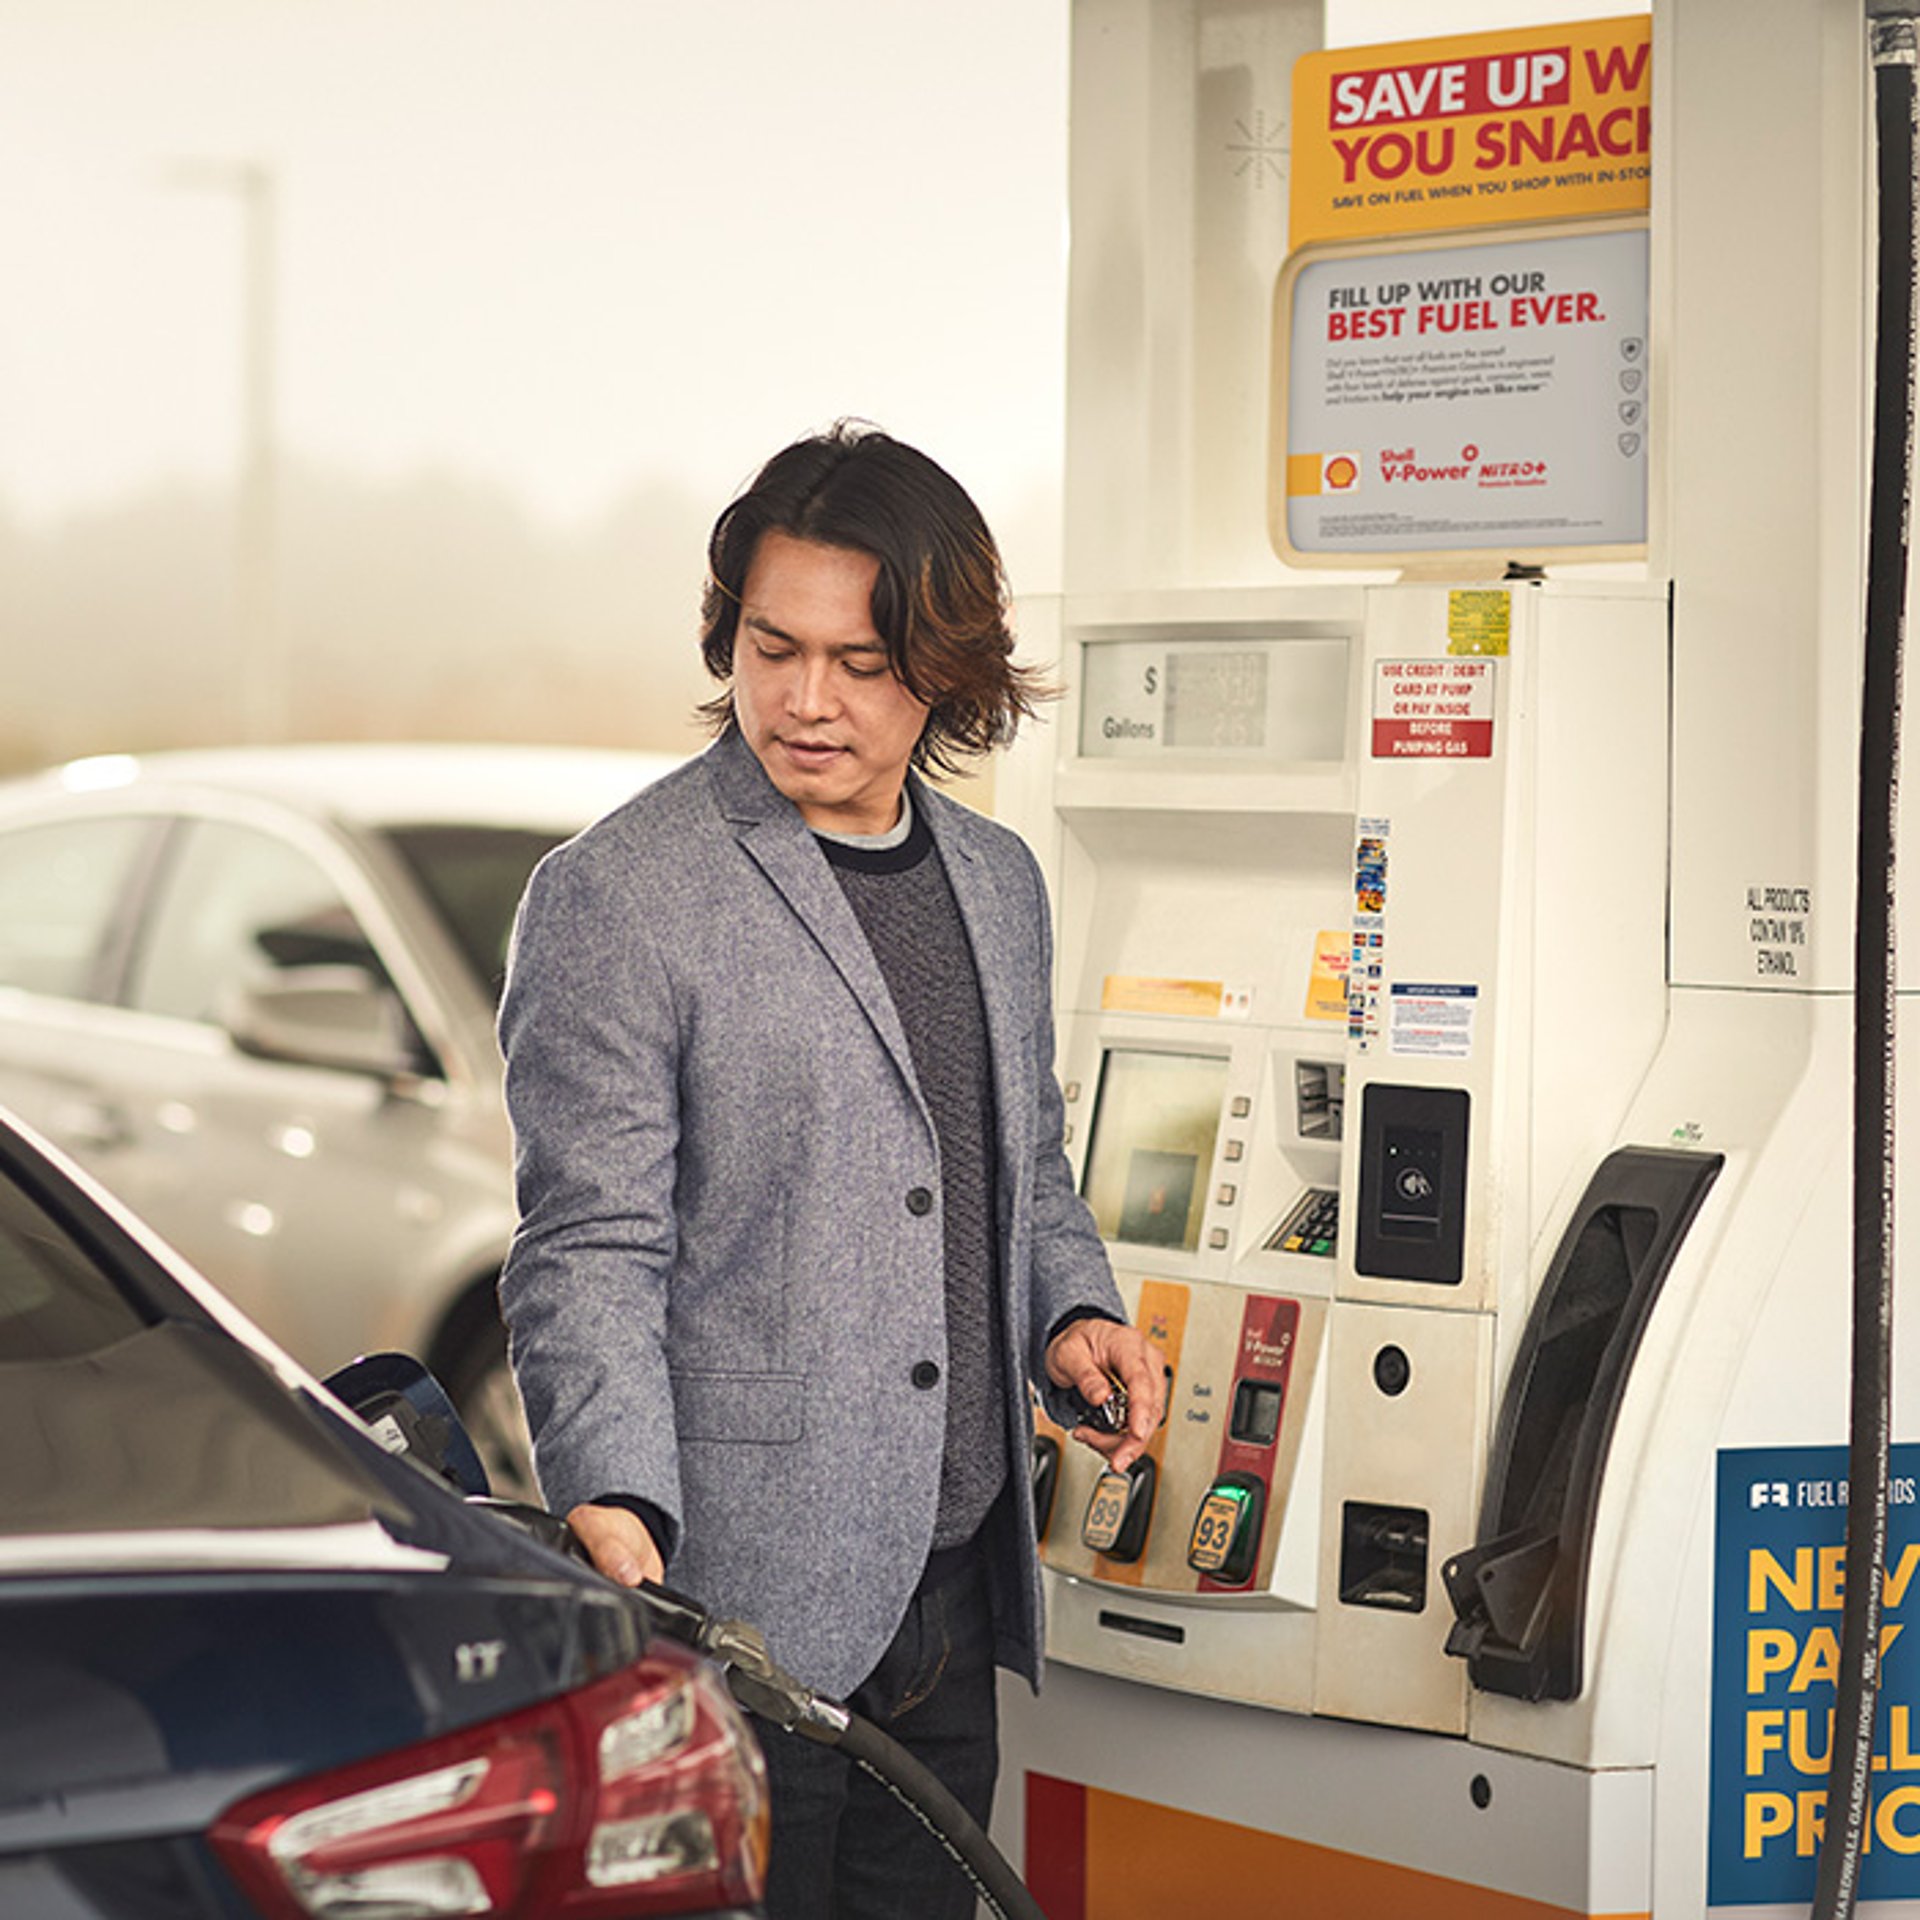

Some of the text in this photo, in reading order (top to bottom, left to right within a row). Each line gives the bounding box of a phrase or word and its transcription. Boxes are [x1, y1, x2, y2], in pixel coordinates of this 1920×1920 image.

[1334, 42, 1651, 125] SAVE UP W
[1332, 127, 1455, 183] YOU
[1332, 195, 1363, 209] SAVE
[1368, 193, 1390, 206] ON
[1395, 189, 1424, 203] FUEL
[1429, 184, 1473, 200] WHEN
[1478, 180, 1507, 195] YOU
[1511, 176, 1552, 192] SHOP
[1555, 171, 1593, 187] WITH
[1329, 271, 1545, 309] FILL UP WITH OUR
[1327, 292, 1606, 341] BEST FUEL EVER.
[1382, 391, 1405, 403] help
[1407, 389, 1432, 402] your
[1435, 386, 1470, 401] engine
[1473, 386, 1491, 395] run
[1494, 382, 1514, 393] like
[1380, 448, 1415, 463] Shell
[1380, 464, 1471, 483] V-Power
[1144, 665, 1157, 695] $
[1382, 664, 1402, 677] USE
[1406, 664, 1443, 677] CREDIT
[1453, 664, 1485, 677] DEBIT
[1393, 683, 1472, 696] CARD AT PUMP
[1393, 703, 1471, 716] OR PAY INSIDE
[1103, 716, 1155, 739] Gallons
[1409, 722, 1452, 735] BEFORE
[1393, 741, 1468, 754] PUMPING GAS
[1765, 888, 1811, 913] PRODUCTS
[1797, 1480, 1836, 1507] FUEL
[1092, 1497, 1121, 1528] 89
[1197, 1516, 1230, 1550] 93
